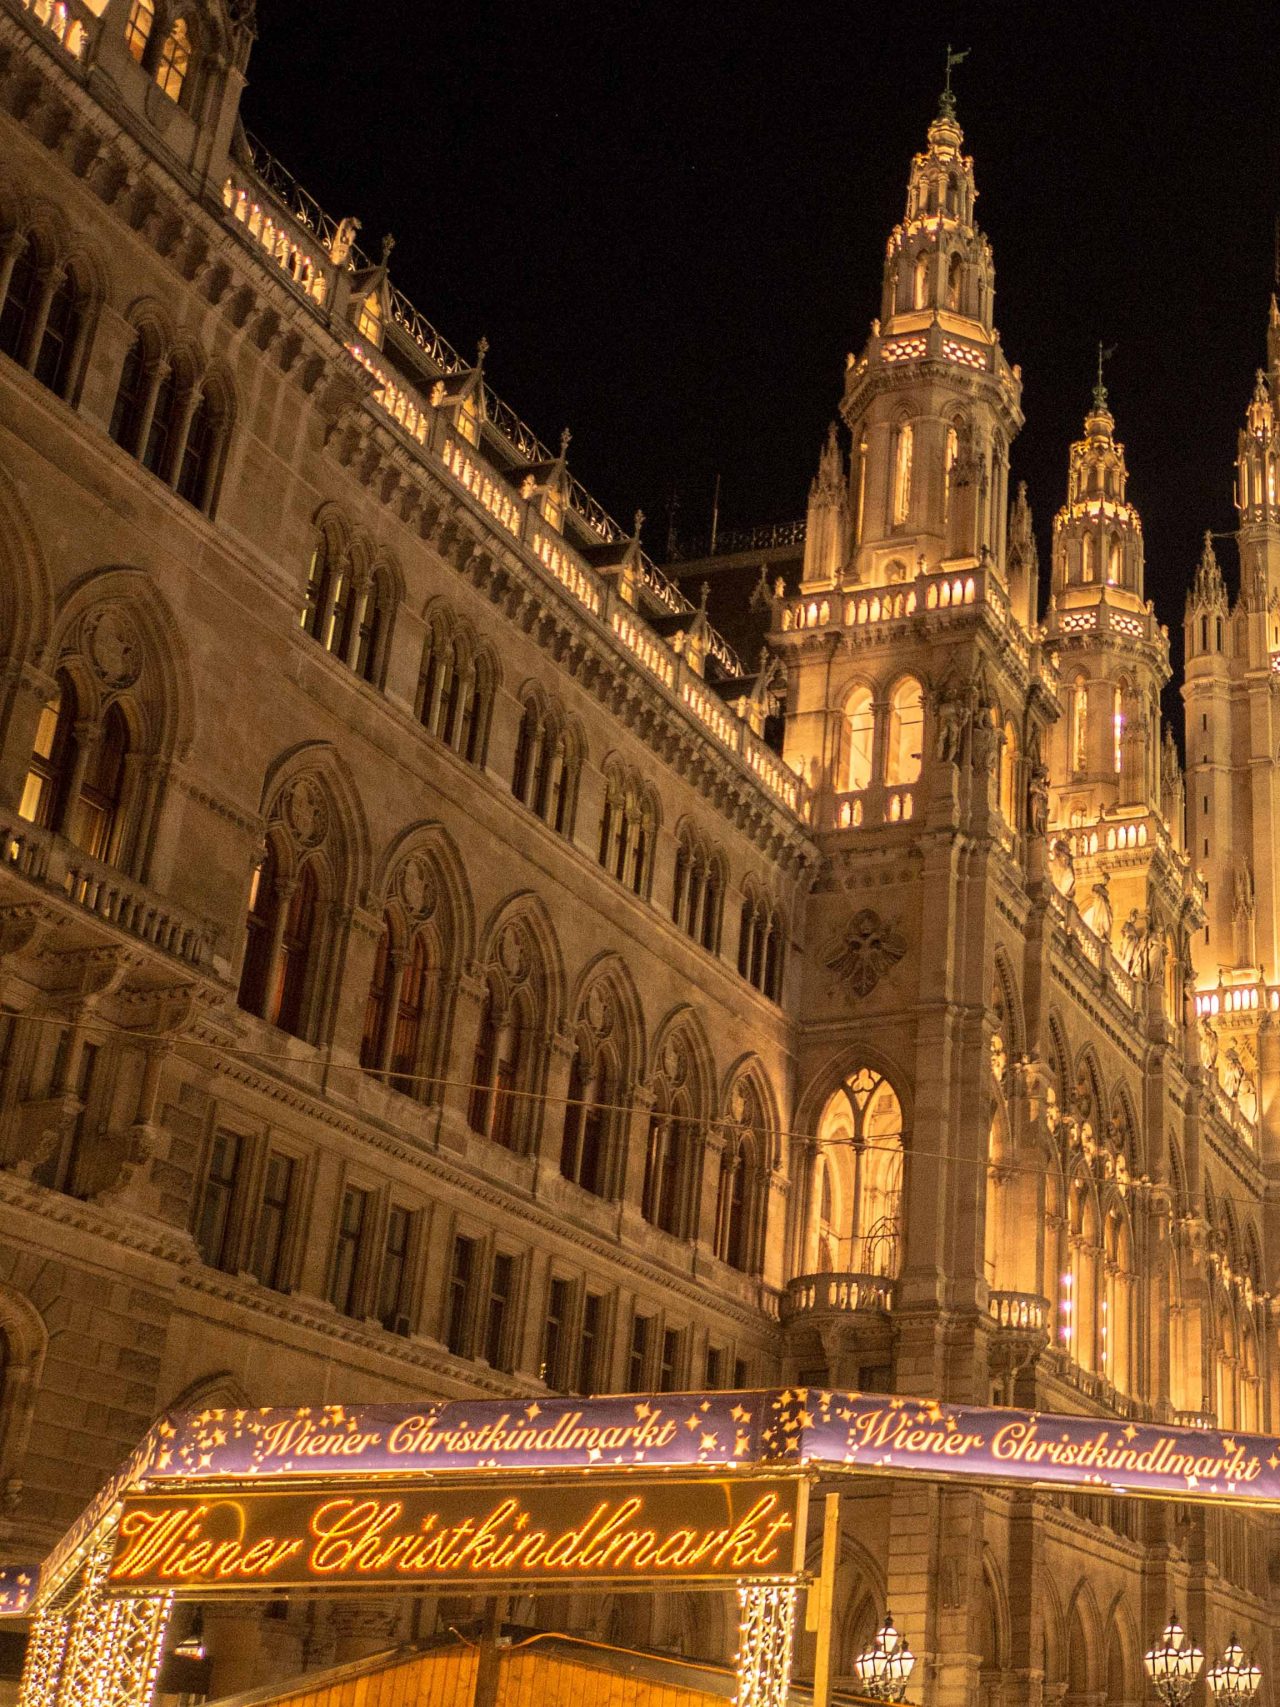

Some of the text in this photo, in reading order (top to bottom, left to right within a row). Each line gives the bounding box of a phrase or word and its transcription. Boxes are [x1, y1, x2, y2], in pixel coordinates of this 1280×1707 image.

[263, 1409, 678, 1457] Wiener Christkindlmarkt
[855, 1409, 1262, 1482] Wiener Christkindlmarkt
[110, 1493, 793, 1578] Wiener Christkindlmarkt
